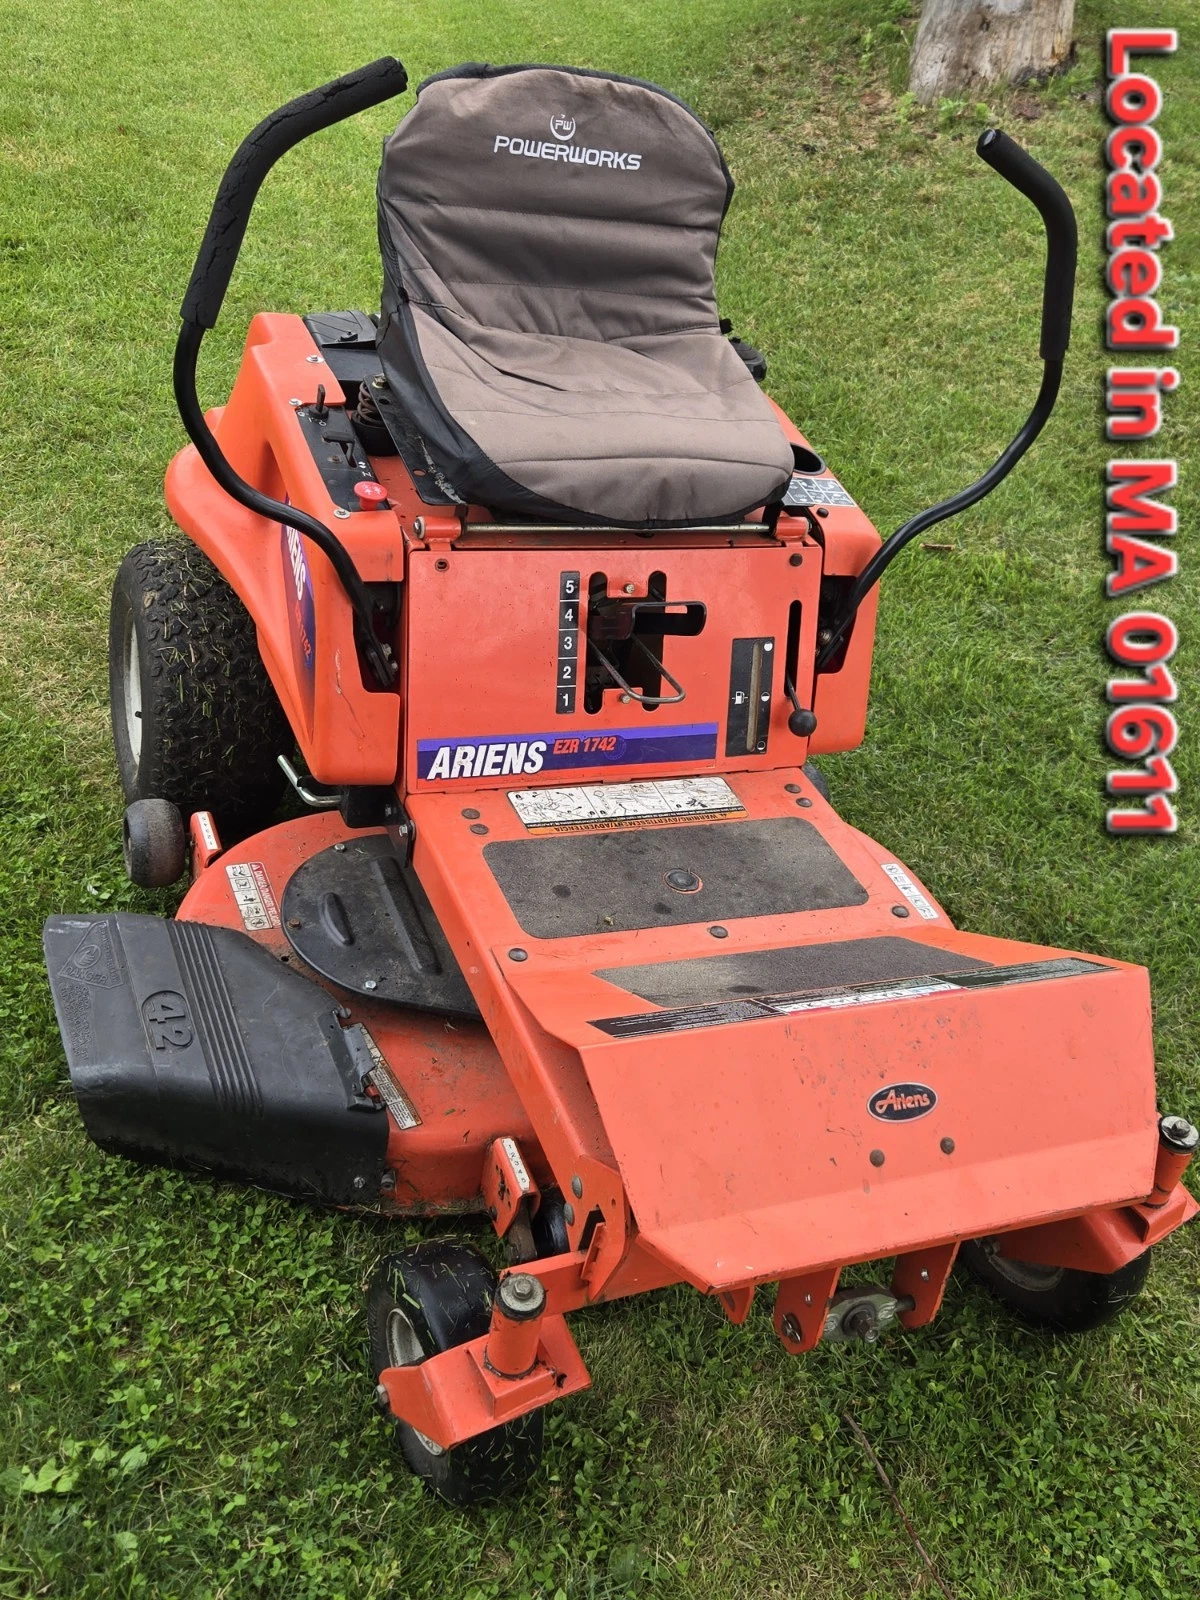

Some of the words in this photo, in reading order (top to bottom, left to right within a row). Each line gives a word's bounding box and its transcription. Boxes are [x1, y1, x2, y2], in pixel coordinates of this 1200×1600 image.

[493, 135, 643, 171] POWERWORKS
[565, 580, 575, 594] 5
[564, 608, 574, 622] 4
[563, 636, 573, 650] 3
[562, 665, 572, 679] 2
[562, 693, 569, 707] 1
[426, 740, 548, 780] ARIENS
[553, 738, 581, 755] EZR
[583, 736, 618, 752] 1742
[149, 1003, 194, 1051] 42
[875, 1089, 931, 1114] Ariens
